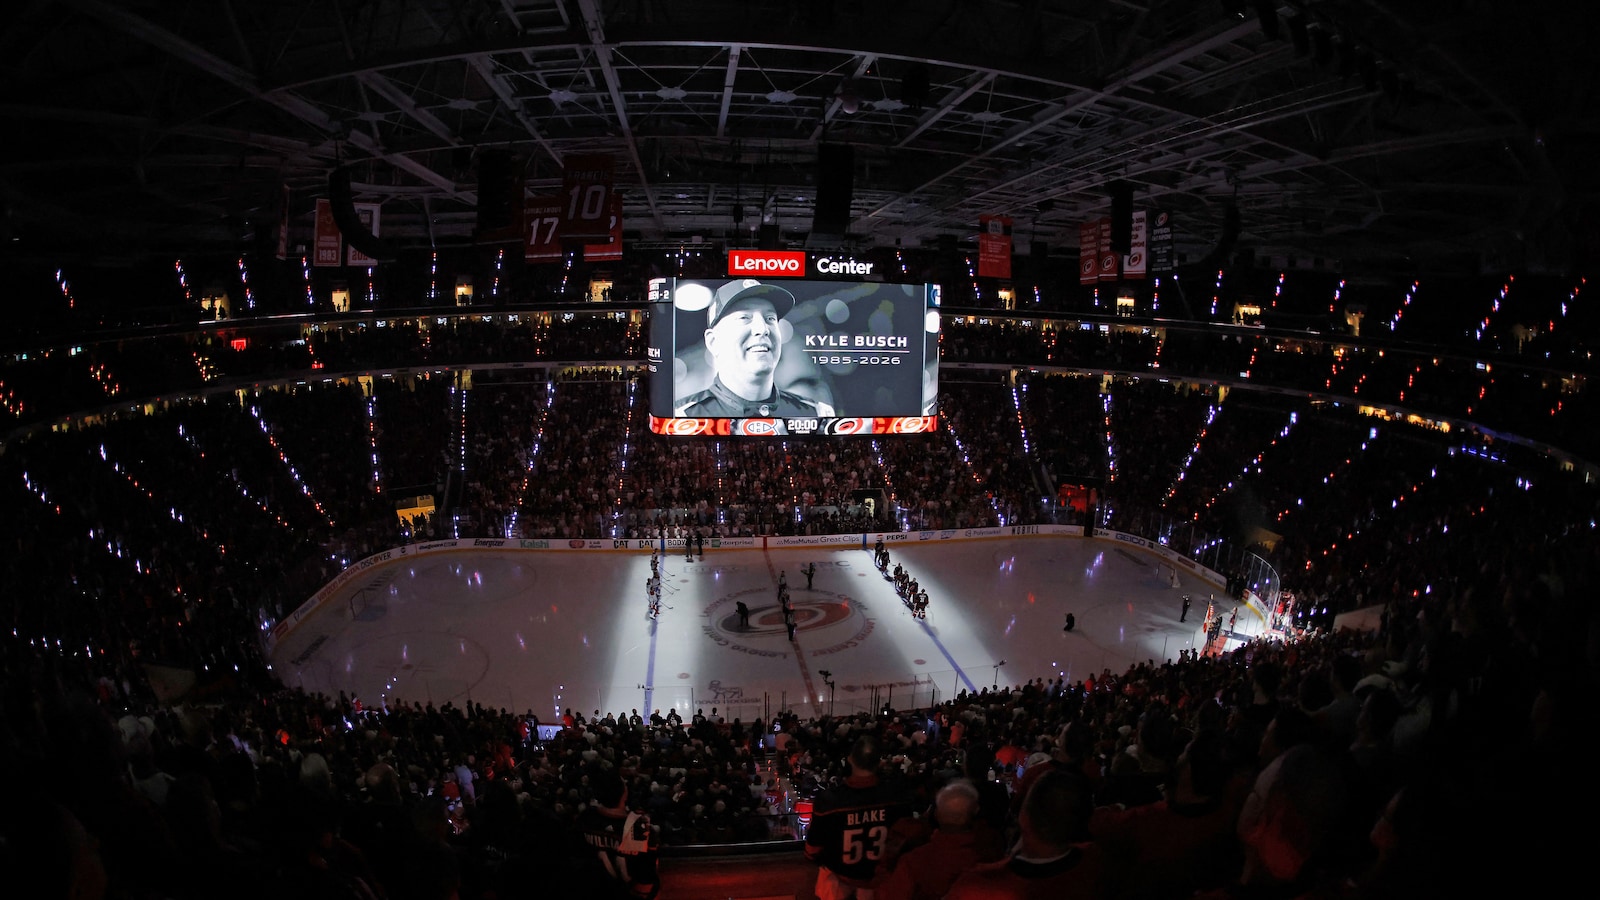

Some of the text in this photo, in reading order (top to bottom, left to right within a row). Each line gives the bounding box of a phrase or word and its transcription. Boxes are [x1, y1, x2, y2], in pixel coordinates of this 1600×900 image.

[567, 185, 607, 220] 10
[529, 217, 559, 245] 17
[735, 256, 873, 274] Lenovo Center
[806, 335, 907, 347] KYLE BUSCH
[812, 356, 900, 365] 1985-2026
[788, 420, 818, 430] 20:00
[474, 539, 505, 548] Energizer
[520, 540, 549, 548] Kalshi
[614, 540, 654, 548] CAT CAT
[843, 535, 860, 543] Clips
[1115, 533, 1146, 546] GEICO
[731, 644, 787, 658] Lenovo
[847, 809, 886, 826] BLAKE
[842, 825, 888, 865] 53
